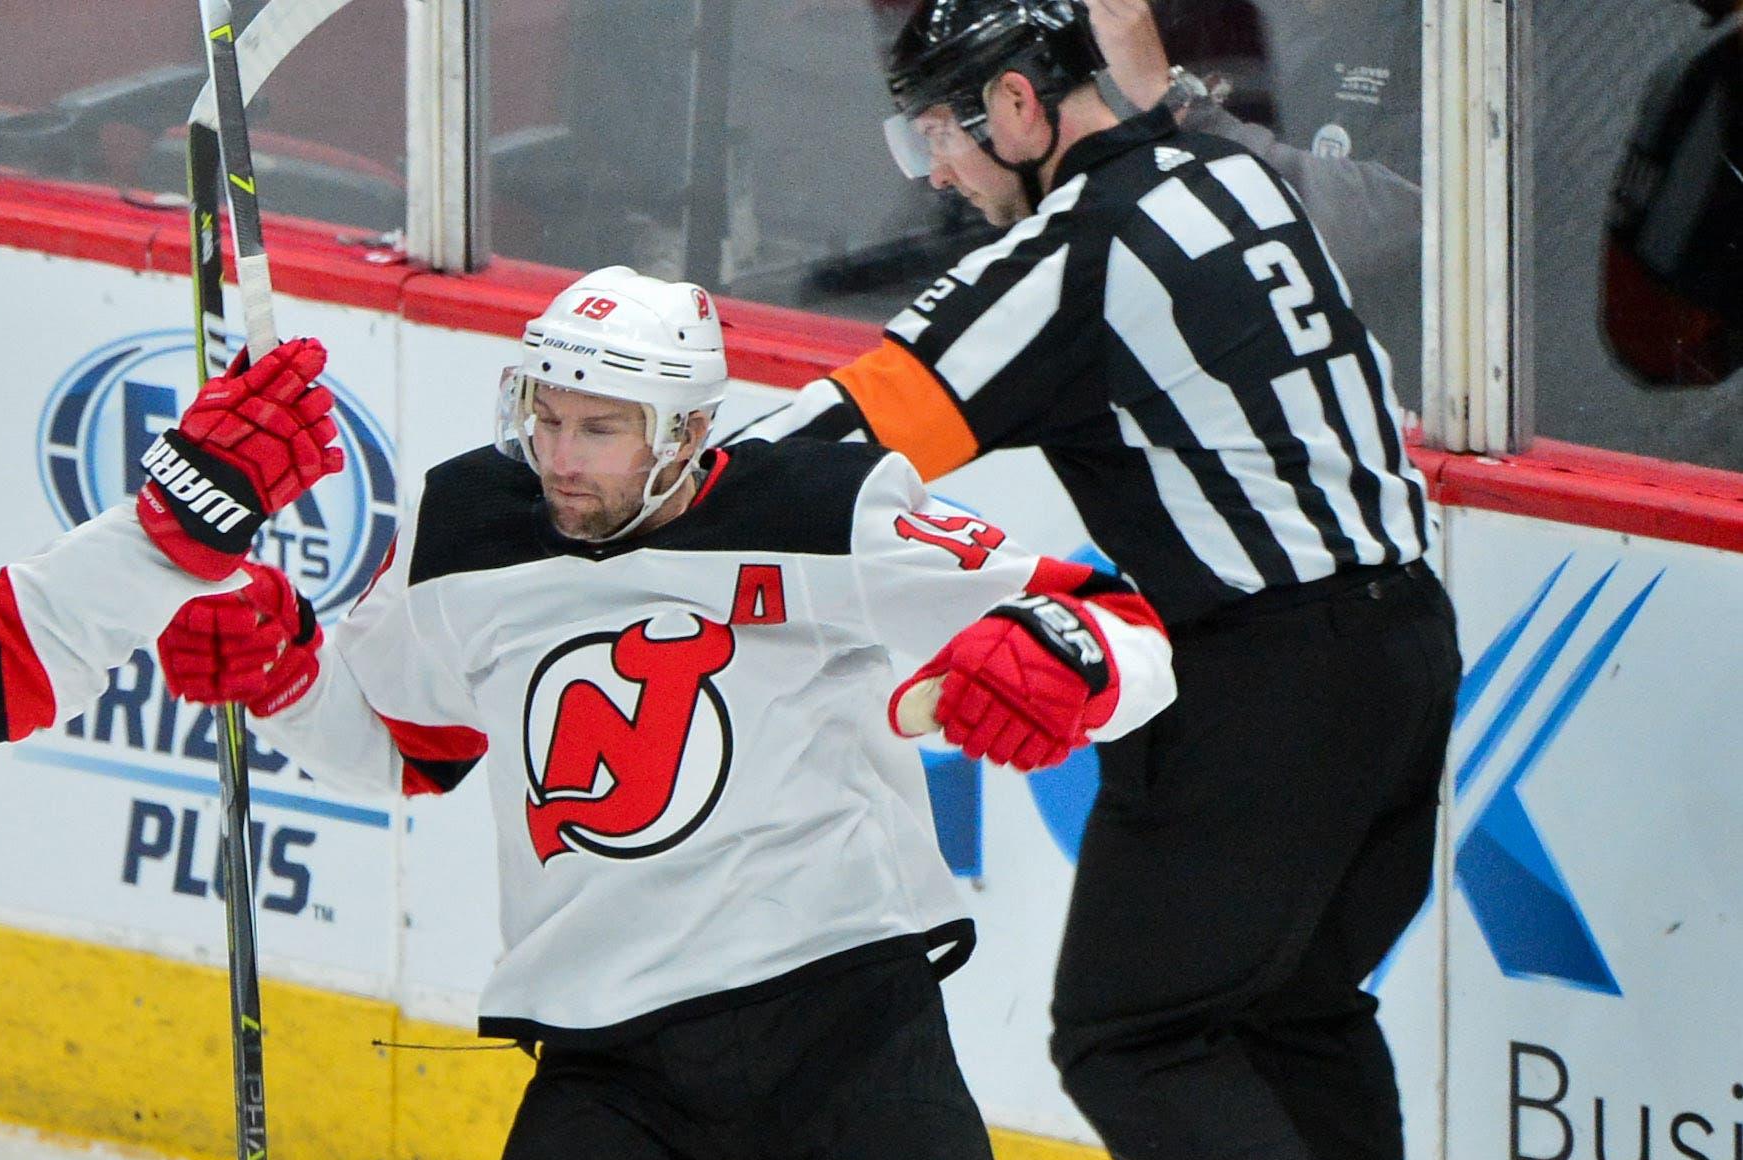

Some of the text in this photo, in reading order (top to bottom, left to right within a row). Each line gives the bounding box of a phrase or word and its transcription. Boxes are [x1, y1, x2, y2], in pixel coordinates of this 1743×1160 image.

[573, 296, 618, 321] 19
[913, 277, 956, 312] 2
[1242, 240, 1333, 357] 2
[732, 564, 787, 624] A
